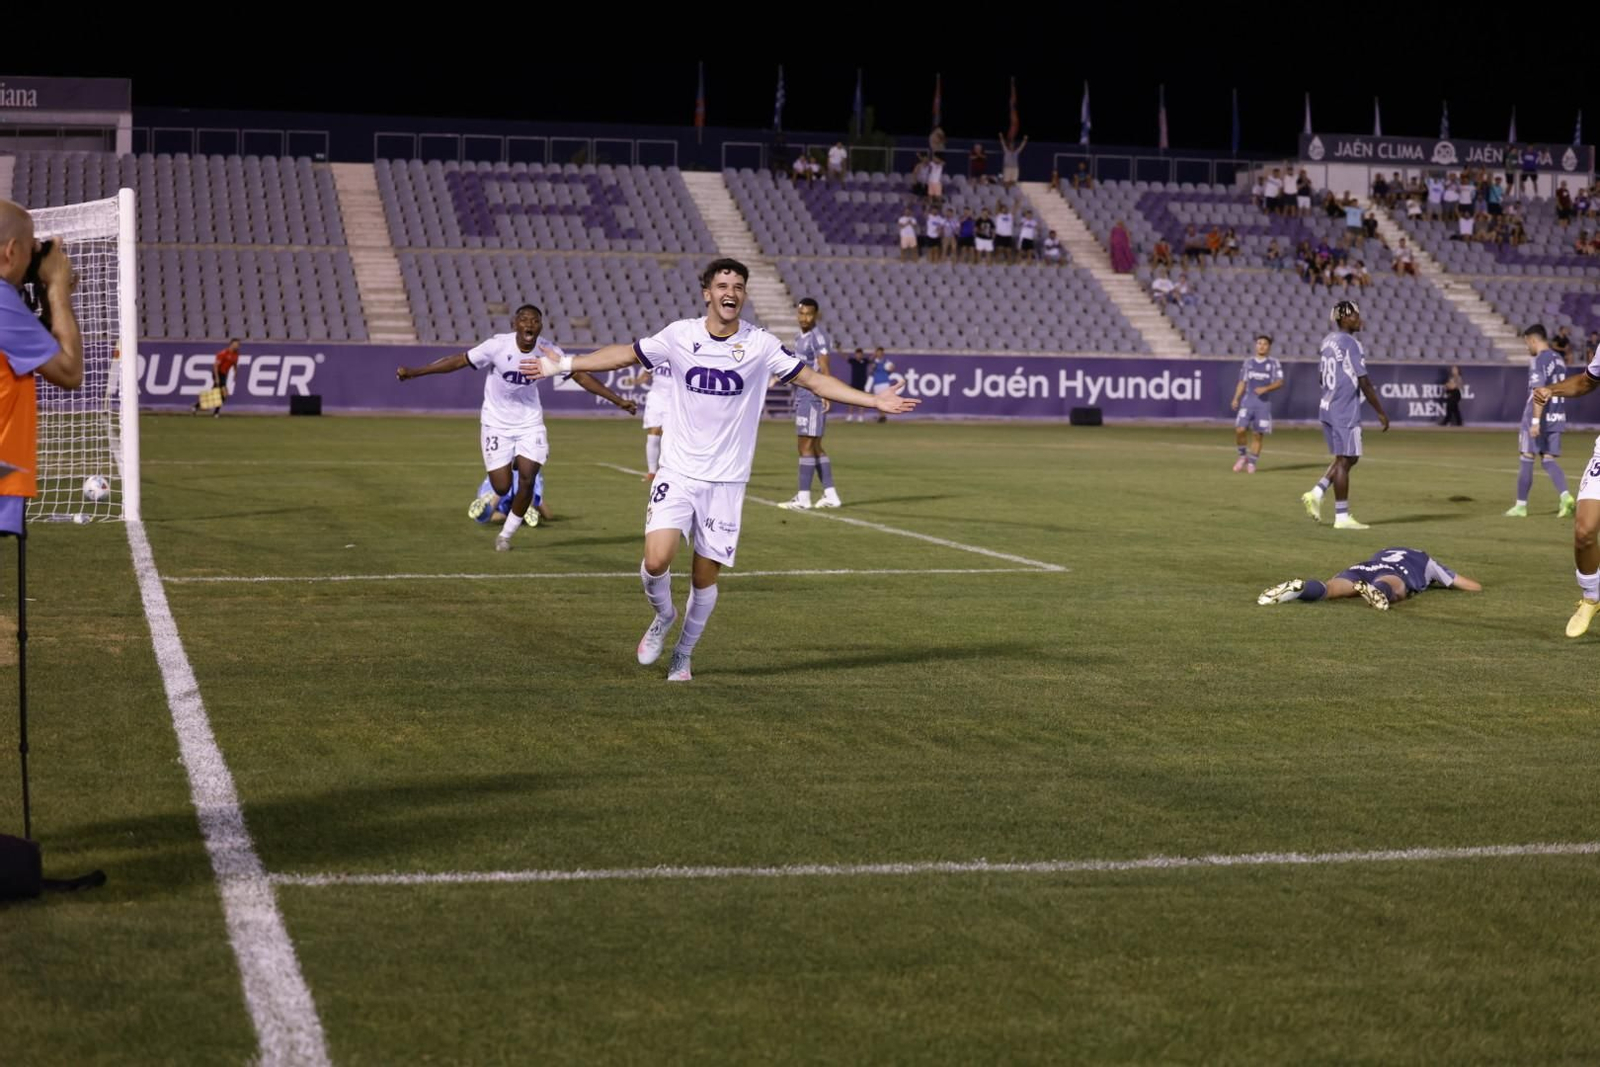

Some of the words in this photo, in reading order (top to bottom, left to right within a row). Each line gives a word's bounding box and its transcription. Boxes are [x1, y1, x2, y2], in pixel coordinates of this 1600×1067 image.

[1334, 139, 1374, 158] JAÉN
[1378, 142, 1424, 160] CLIMA
[1465, 144, 1504, 163] JAÉN
[962, 366, 1049, 398] Jaén
[1059, 369, 1202, 406] Hyundai
[1380, 383, 1419, 399] CAJA
[1408, 400, 1448, 417] JAÉN
[485, 436, 499, 452] 23
